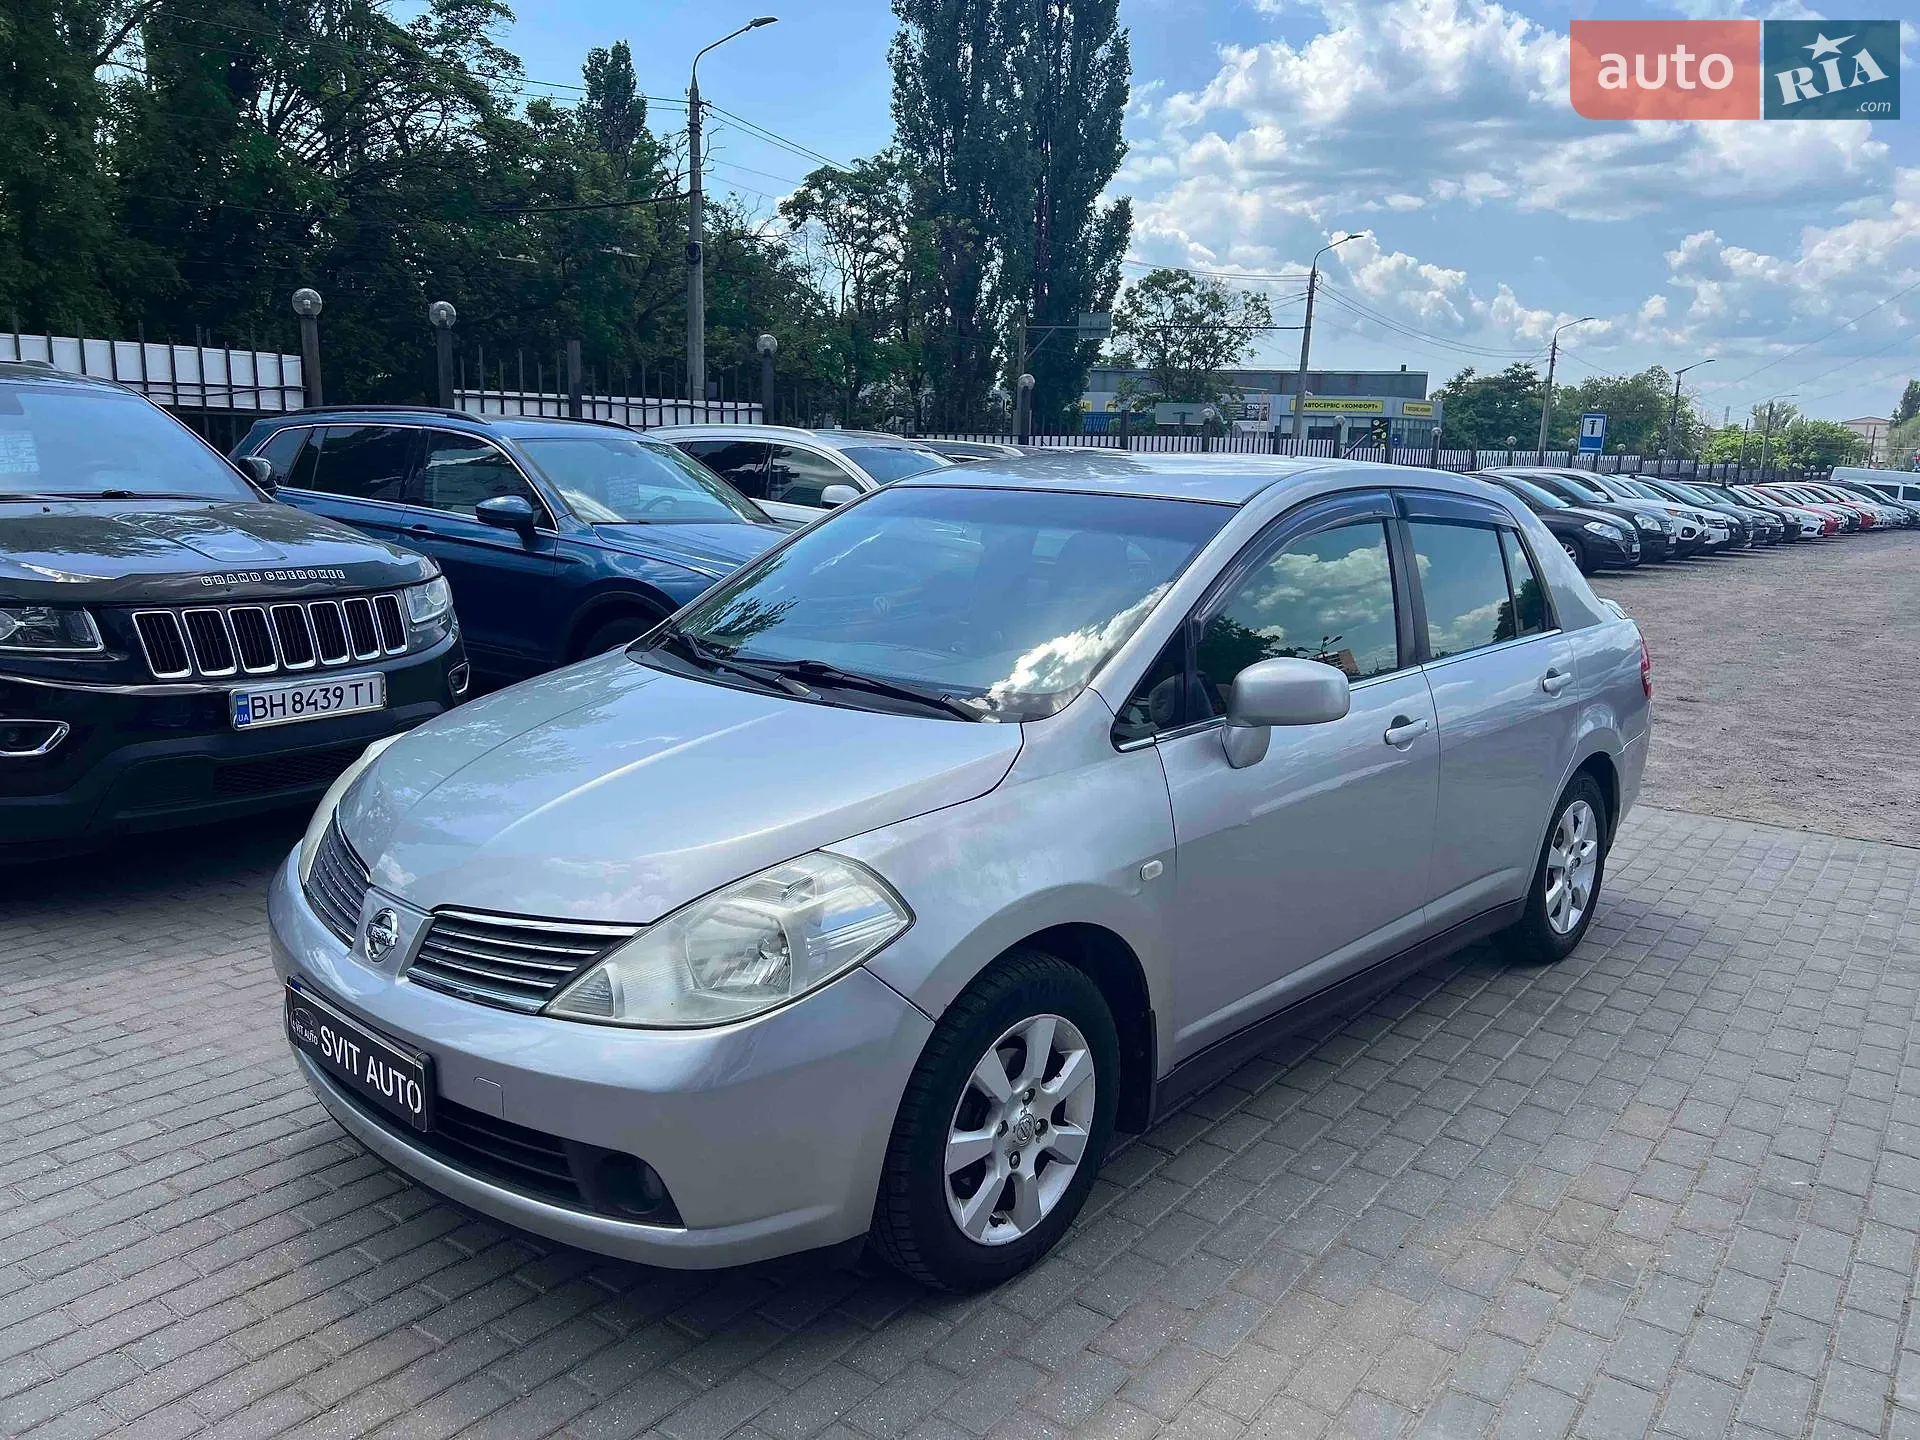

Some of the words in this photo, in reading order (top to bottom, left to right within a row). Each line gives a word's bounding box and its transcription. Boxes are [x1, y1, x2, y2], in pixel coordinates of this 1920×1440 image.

[201, 571, 262, 586] GRAND
[264, 569, 346, 582] CHEROKEE
[238, 713, 250, 722] UA
[320, 1025, 361, 1075] SVIT
[366, 1055, 422, 1114] AUTO
